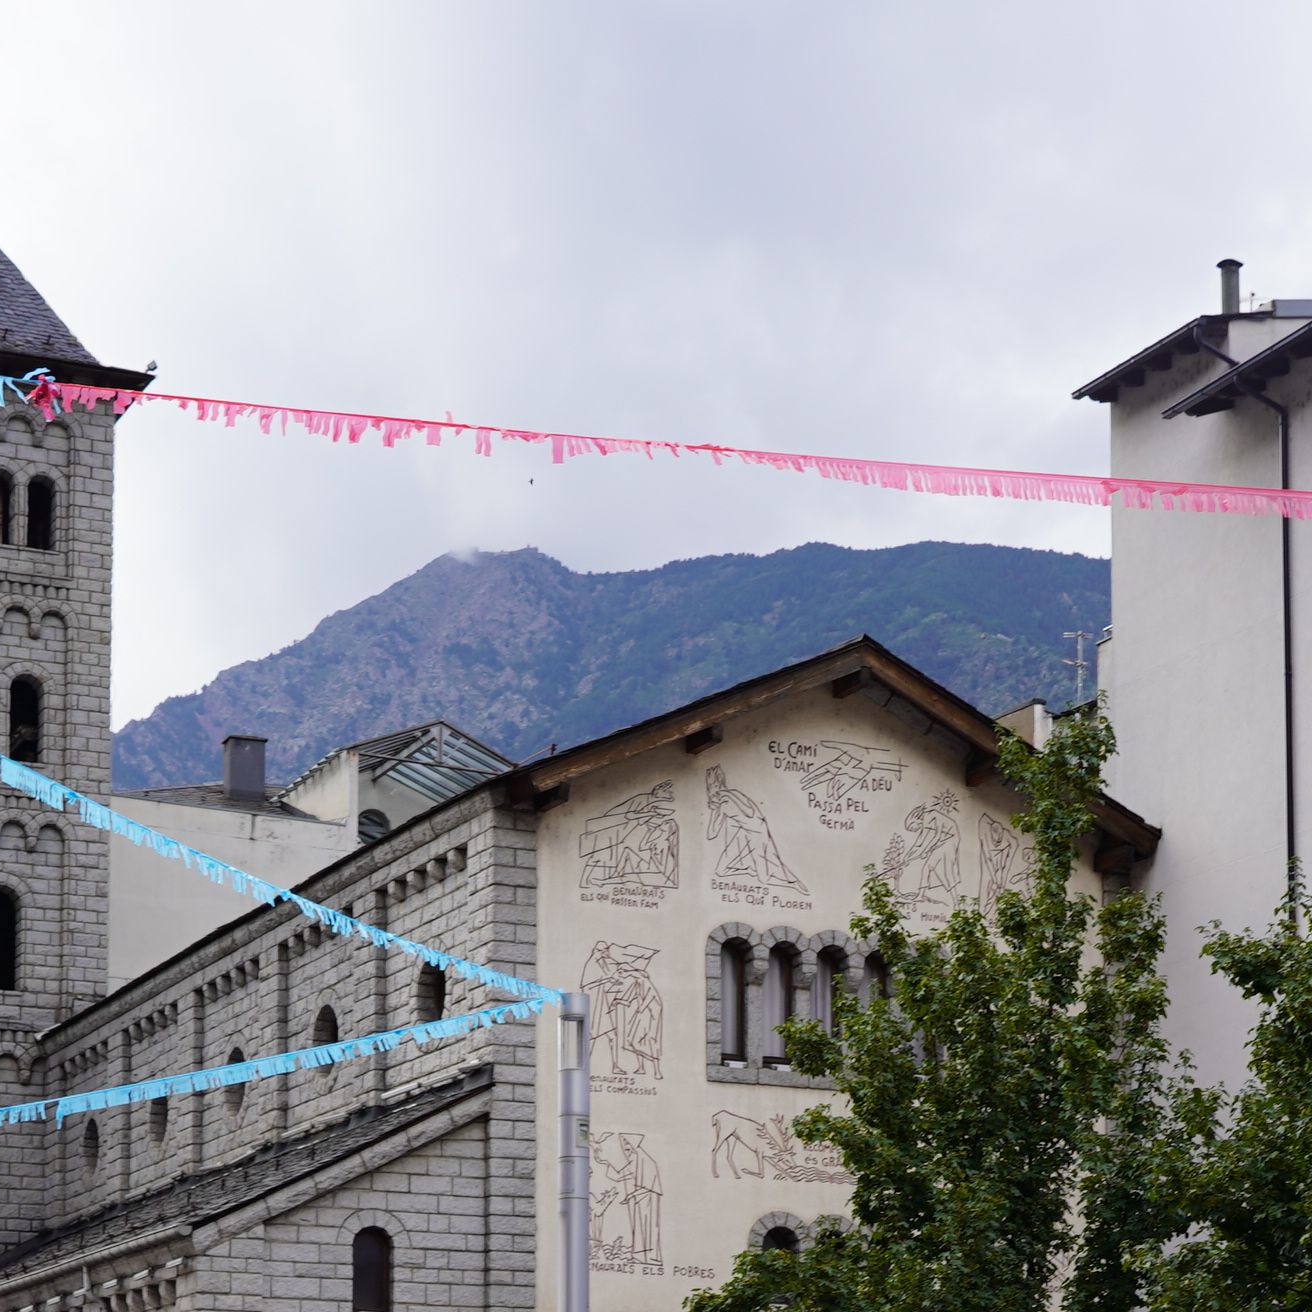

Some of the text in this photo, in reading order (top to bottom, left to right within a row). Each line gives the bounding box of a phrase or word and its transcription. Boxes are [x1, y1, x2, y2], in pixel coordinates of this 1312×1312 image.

[768, 741, 784, 754] EL
[859, 779, 869, 791] A
[808, 792, 869, 814] PASSA PEL
[721, 893, 739, 903] ELS
[640, 899, 658, 910] FAM
[642, 1266, 664, 1276] ELS
[673, 1265, 715, 1280] POBRES
